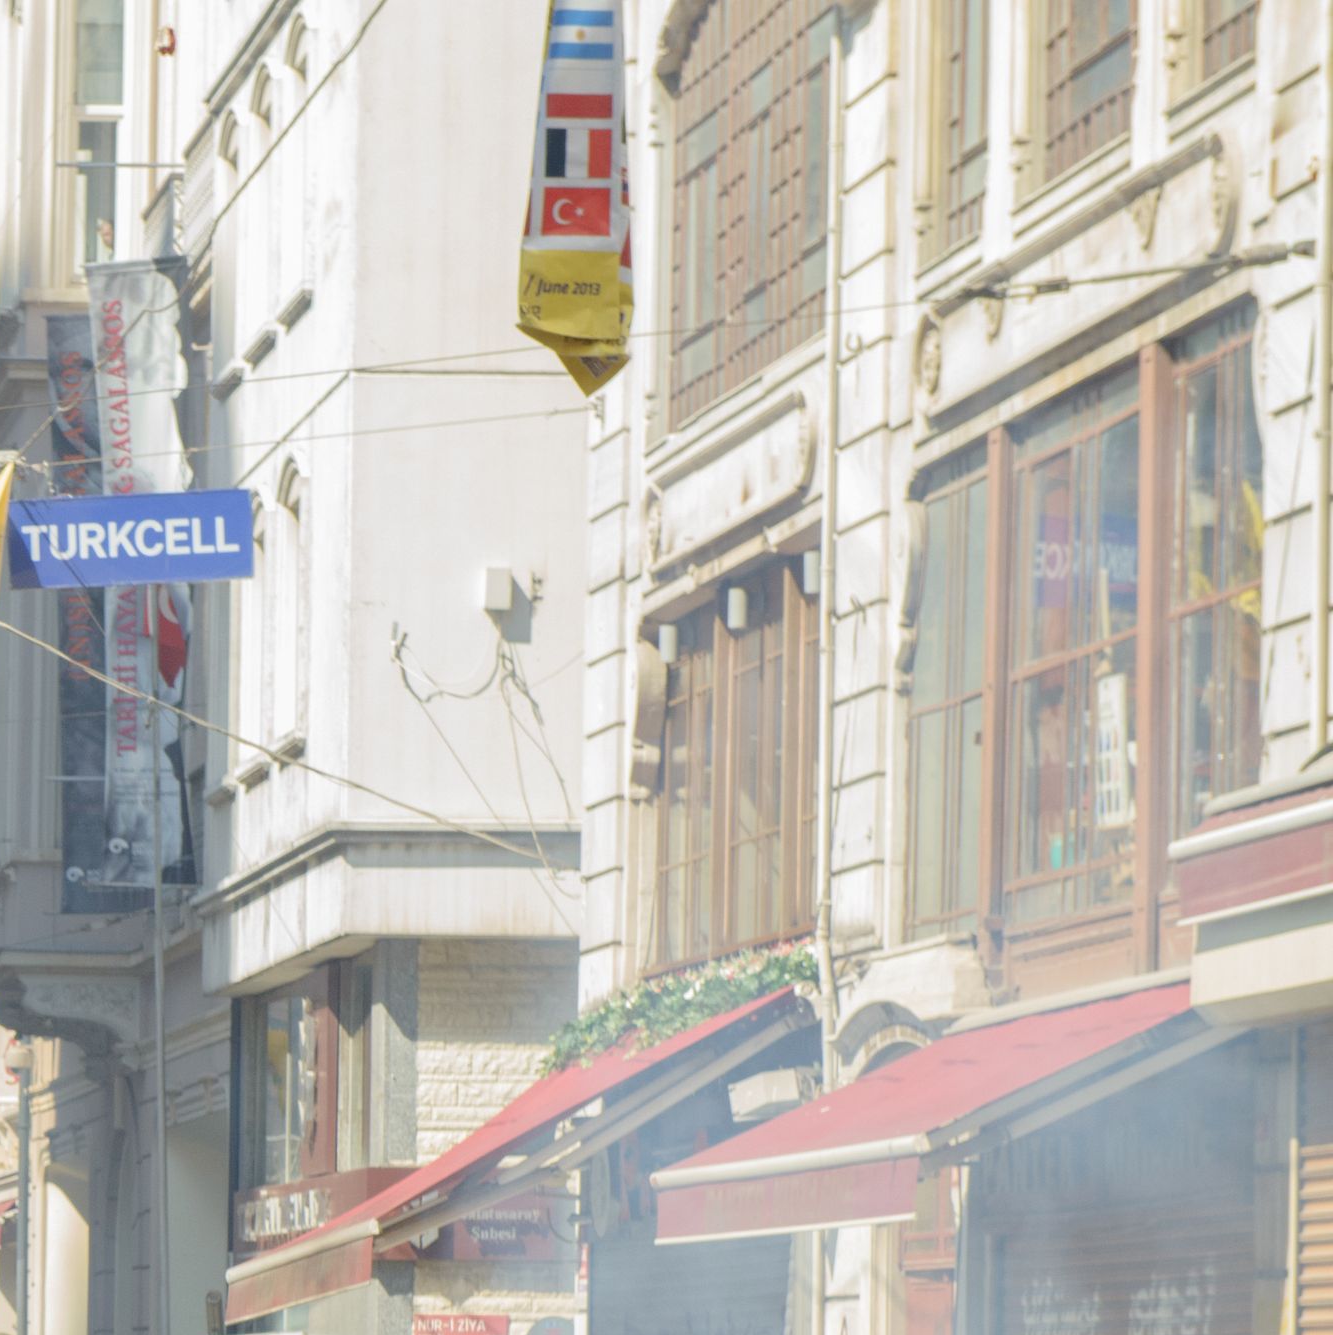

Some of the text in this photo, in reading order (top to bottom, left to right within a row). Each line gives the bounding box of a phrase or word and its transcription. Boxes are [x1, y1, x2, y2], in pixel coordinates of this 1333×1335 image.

[536, 279, 569, 297] June
[572, 281, 601, 296] 2013
[21, 516, 241, 562] TURKCELL
[116, 588, 138, 657] HAYA
[457, 1316, 486, 1333] ZİYA
